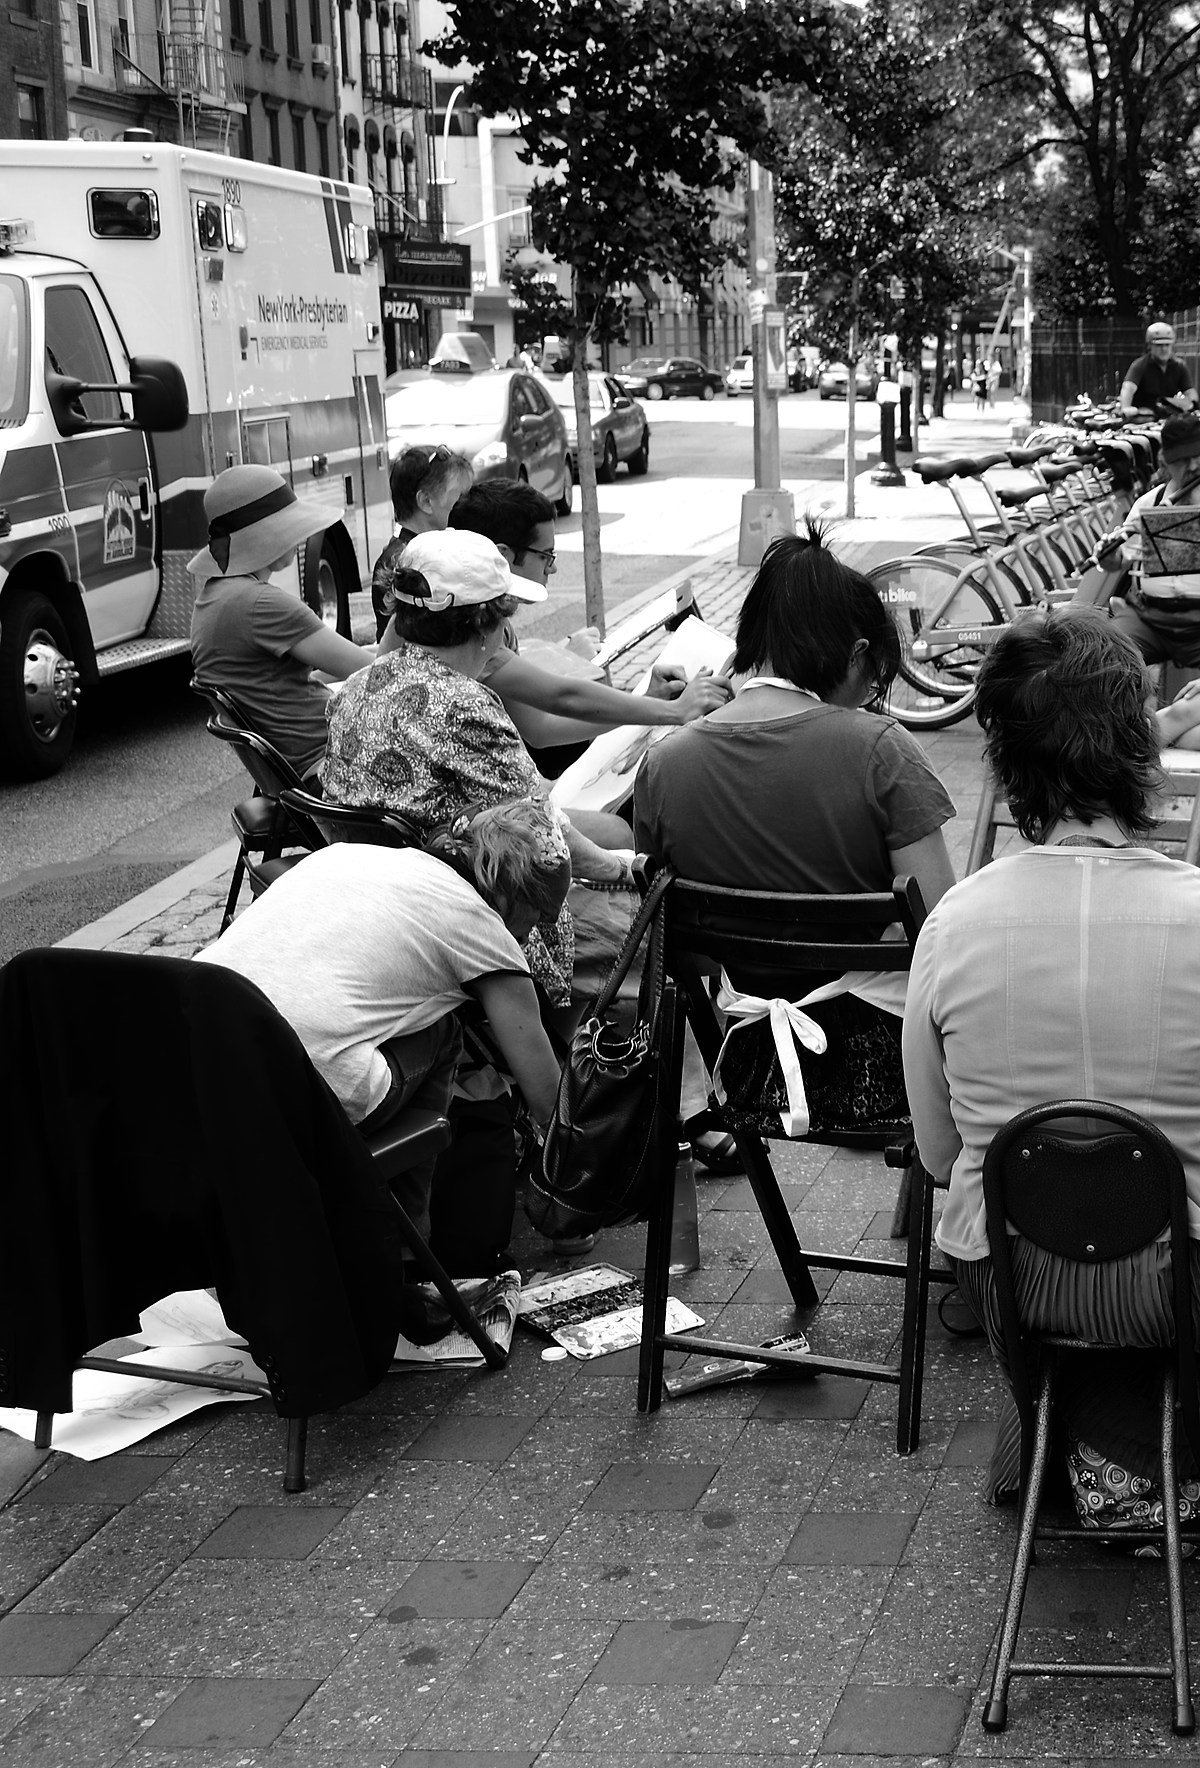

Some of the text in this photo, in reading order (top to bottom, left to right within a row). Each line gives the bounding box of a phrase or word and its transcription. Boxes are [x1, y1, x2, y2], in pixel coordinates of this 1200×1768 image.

[222, 178, 241, 204] 1890
[384, 300, 419, 320] PIZZA
[261, 335, 329, 351] EMERGENCY MEDICAL SERVICES
